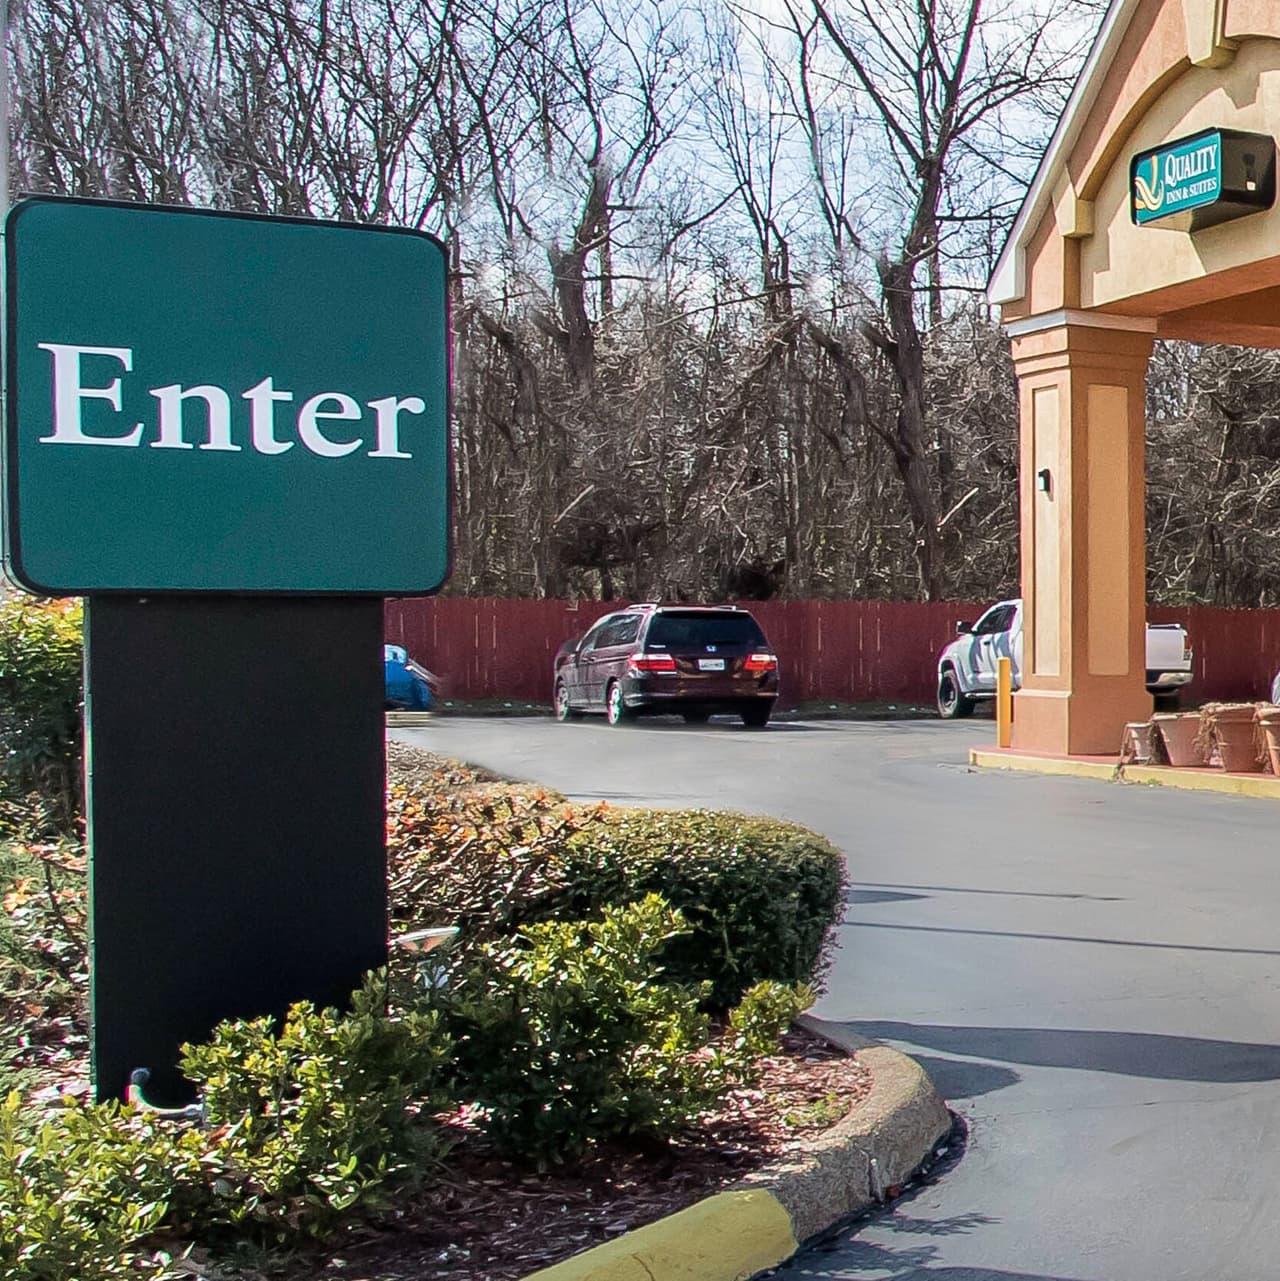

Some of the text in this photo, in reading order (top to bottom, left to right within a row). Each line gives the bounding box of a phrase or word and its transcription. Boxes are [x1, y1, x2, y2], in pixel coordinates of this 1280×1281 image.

[1165, 144, 1217, 187] QUALITY
[1166, 188, 1181, 204] INN
[1189, 177, 1217, 197] SUITES
[38, 342, 426, 459] Enter
